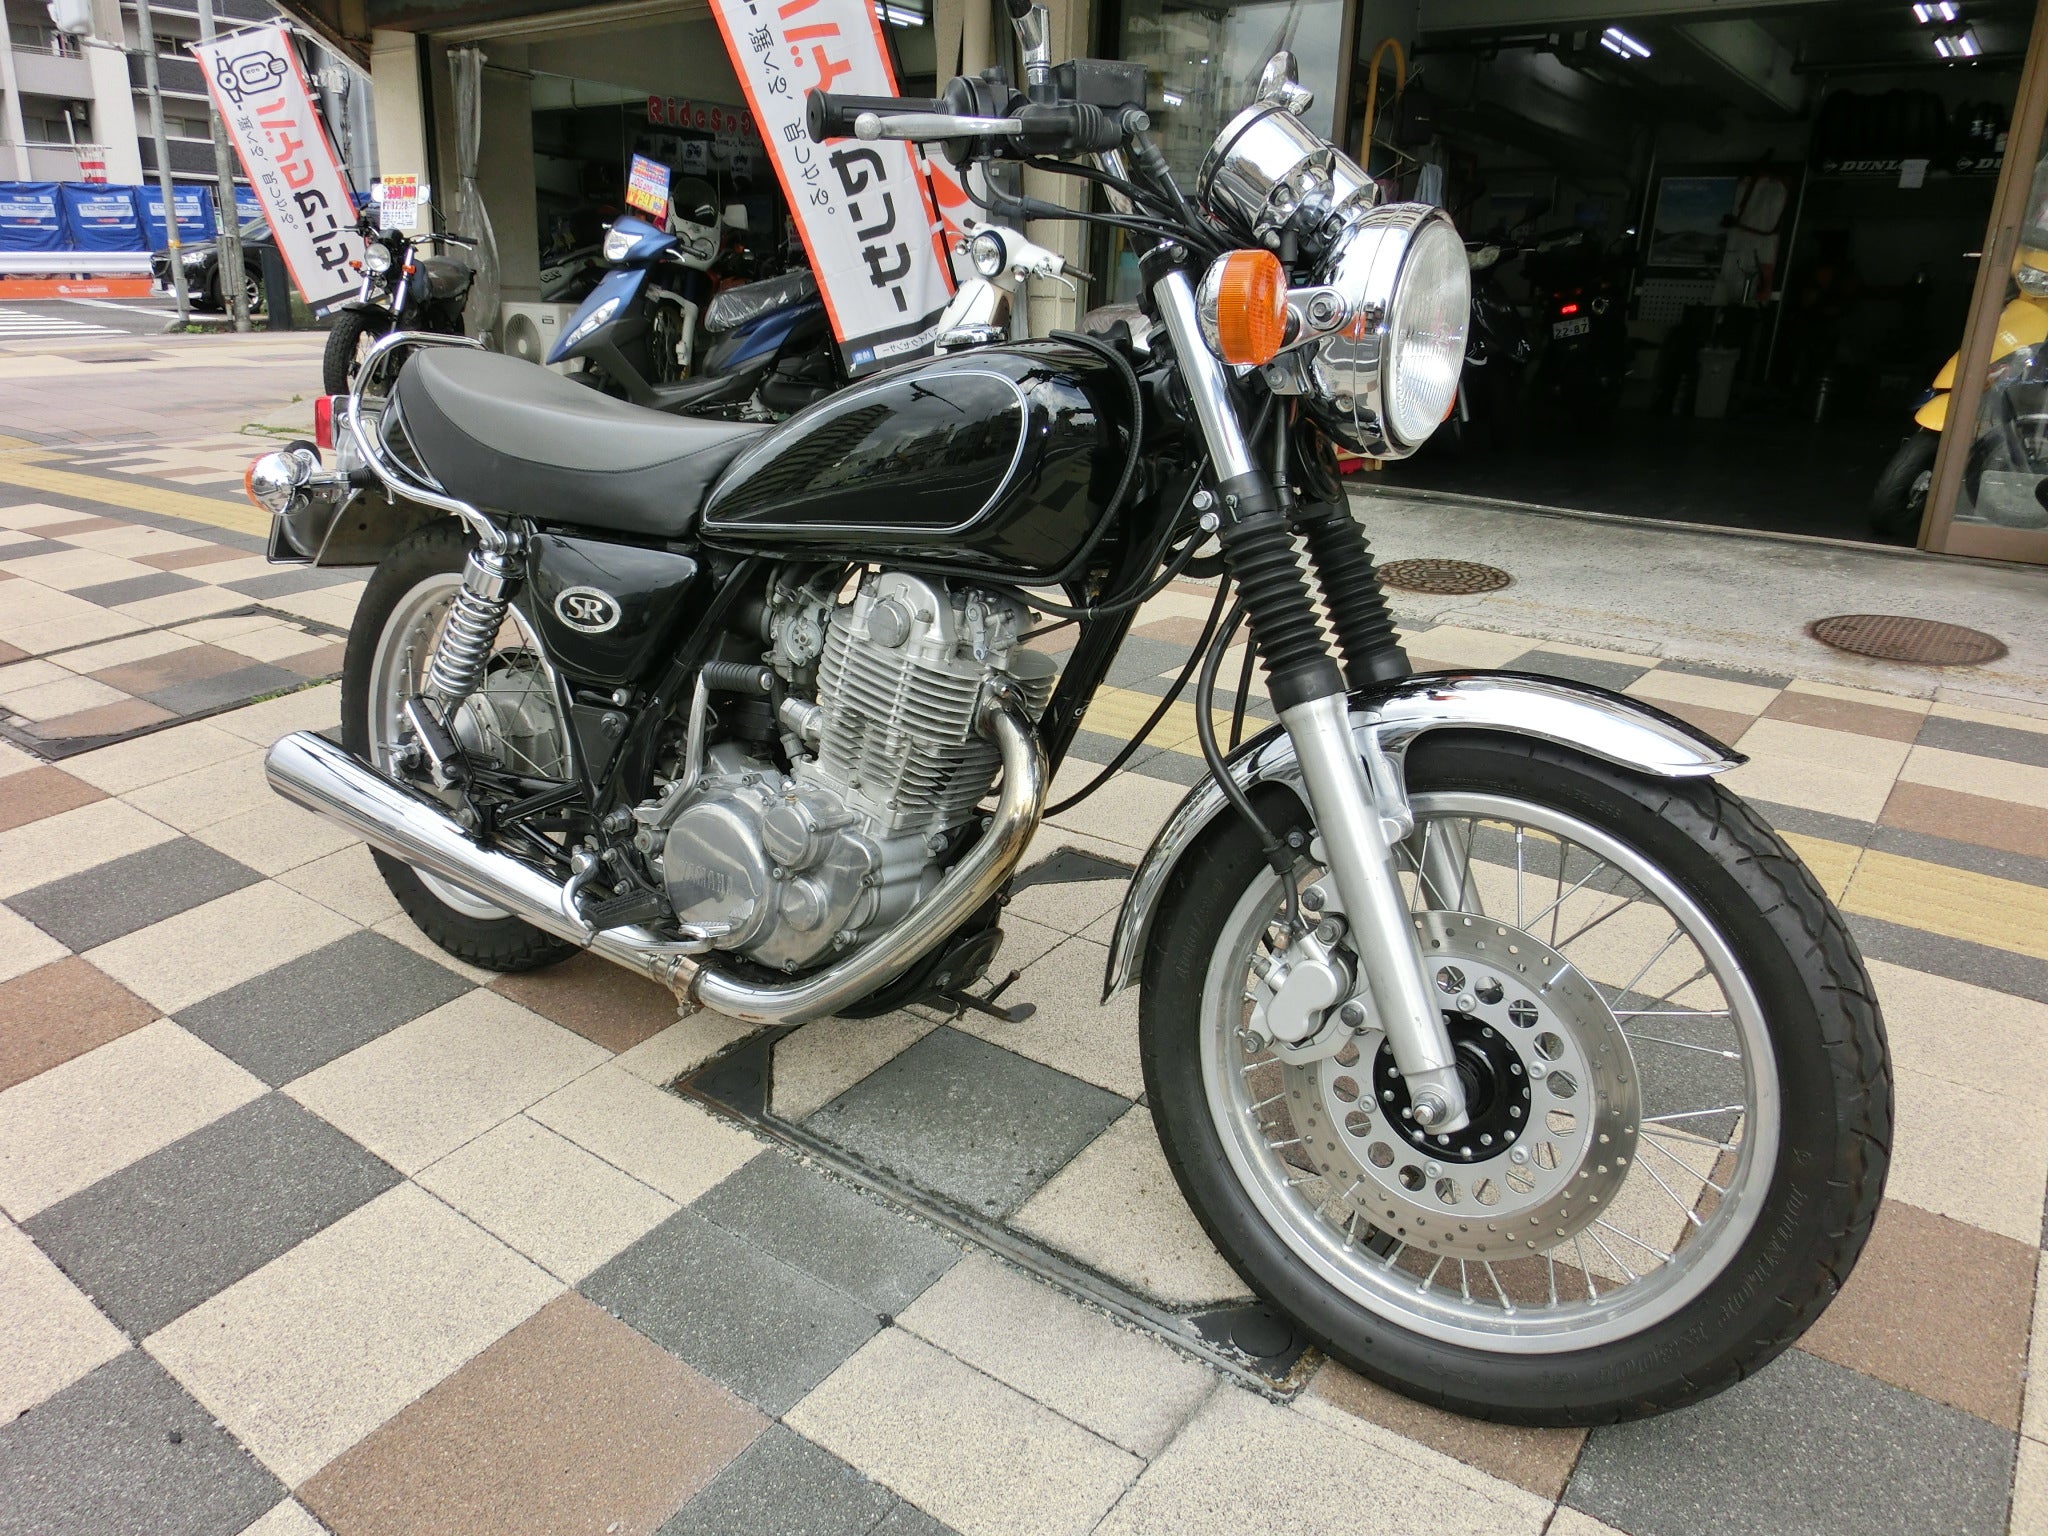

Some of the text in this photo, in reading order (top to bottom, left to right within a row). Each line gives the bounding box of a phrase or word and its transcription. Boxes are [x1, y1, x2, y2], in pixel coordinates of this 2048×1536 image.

[648, 95, 755, 138] RideSpo
[1840, 160, 1904, 171] DUNL
[384, 176, 416, 184] 中古車
[1555, 323, 1588, 337] 22-87
[566, 596, 605, 624] SR
